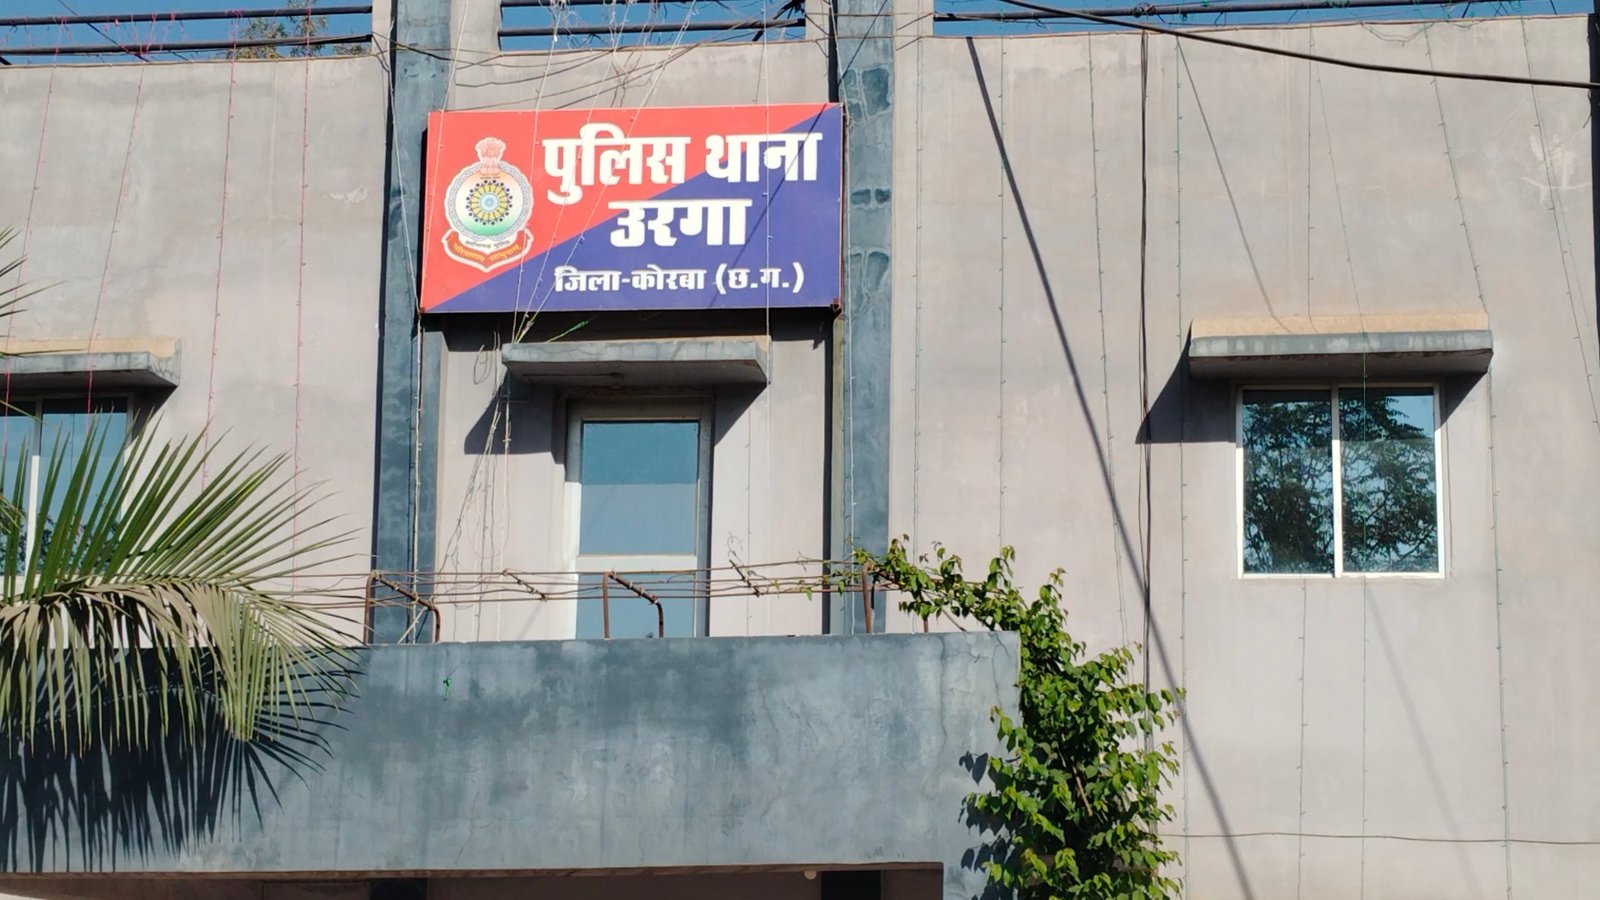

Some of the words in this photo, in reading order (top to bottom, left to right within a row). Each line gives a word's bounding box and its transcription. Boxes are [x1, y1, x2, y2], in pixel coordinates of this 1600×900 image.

[542, 123, 691, 204] पुलिस
[705, 132, 823, 183] थाना
[608, 198, 752, 247] उरगा
[554, 264, 707, 292] जिला-कोरबा
[715, 262, 805, 294] (छ.ग.)
